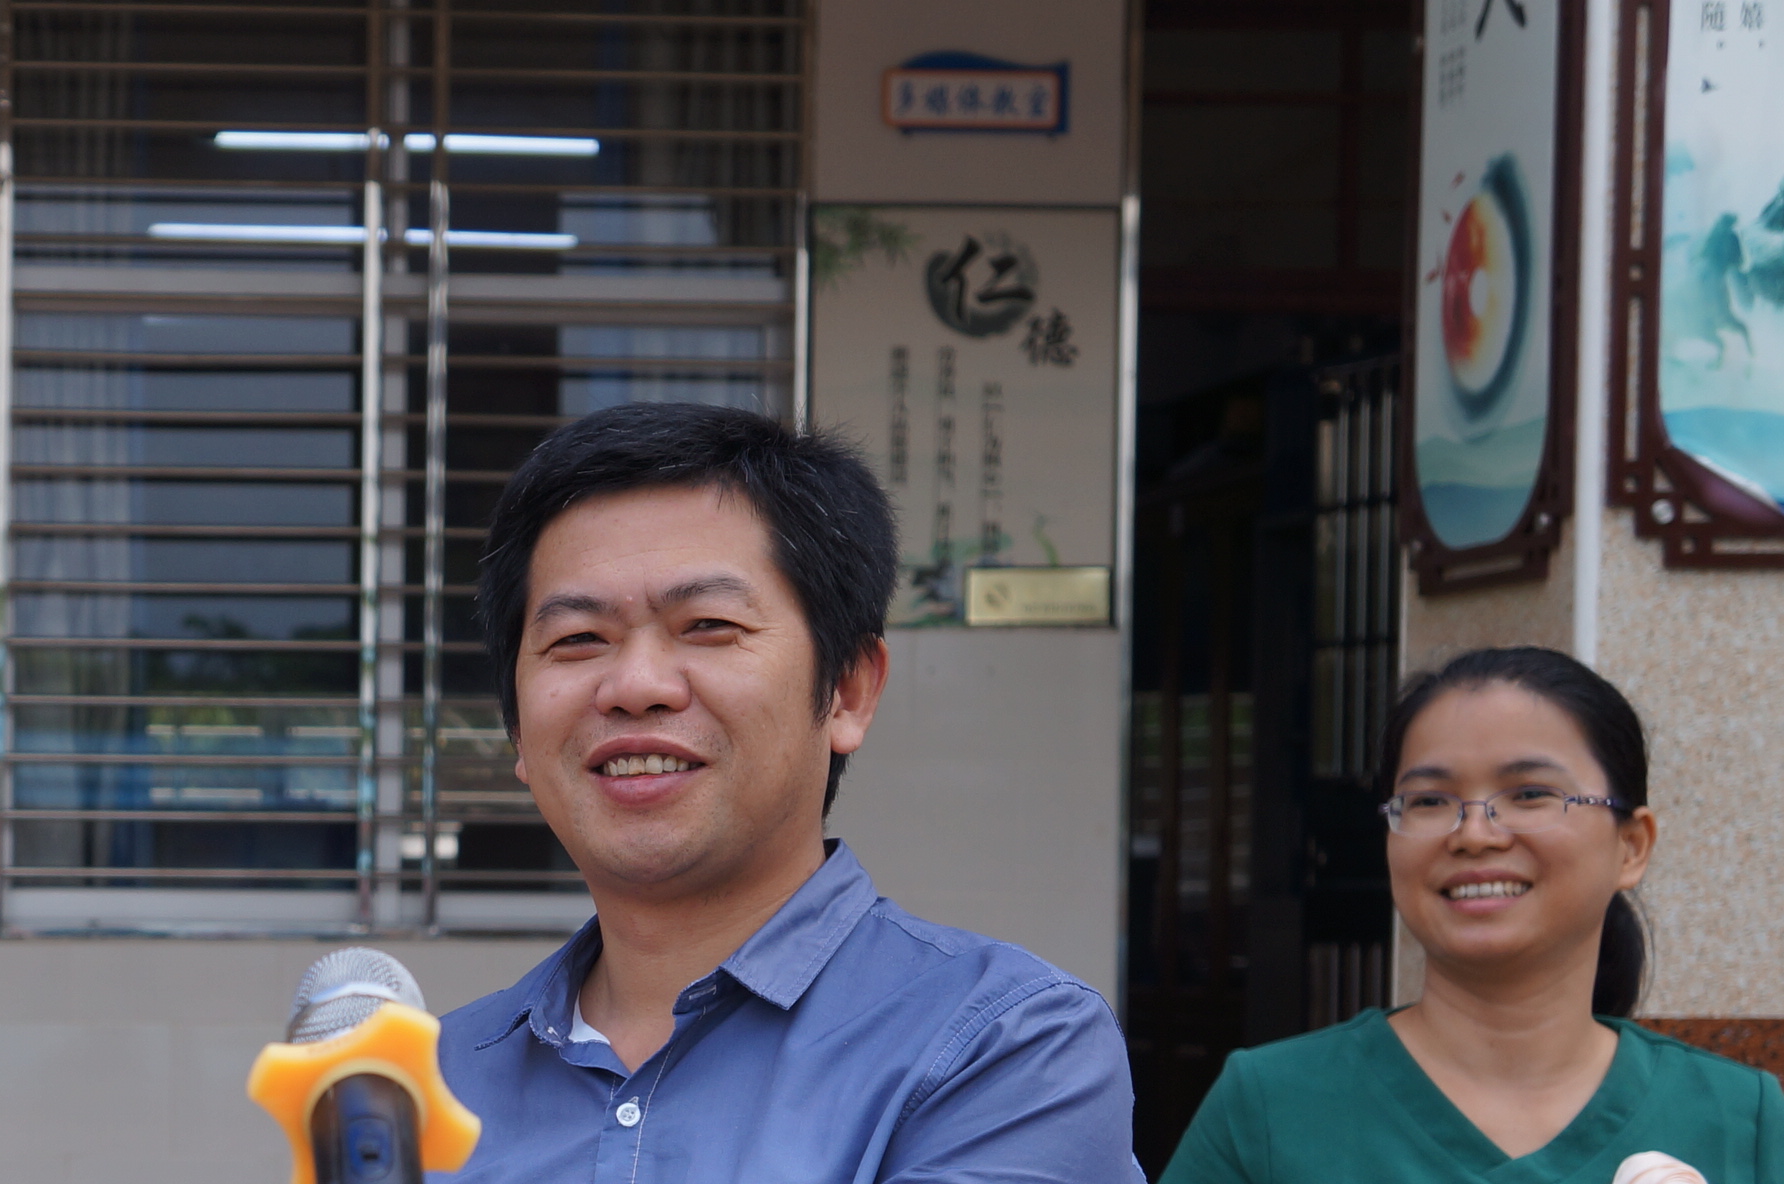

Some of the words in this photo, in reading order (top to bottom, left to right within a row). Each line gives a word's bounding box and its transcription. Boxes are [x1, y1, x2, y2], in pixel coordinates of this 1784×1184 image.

[895, 80, 1048, 117] 多媒体教室
